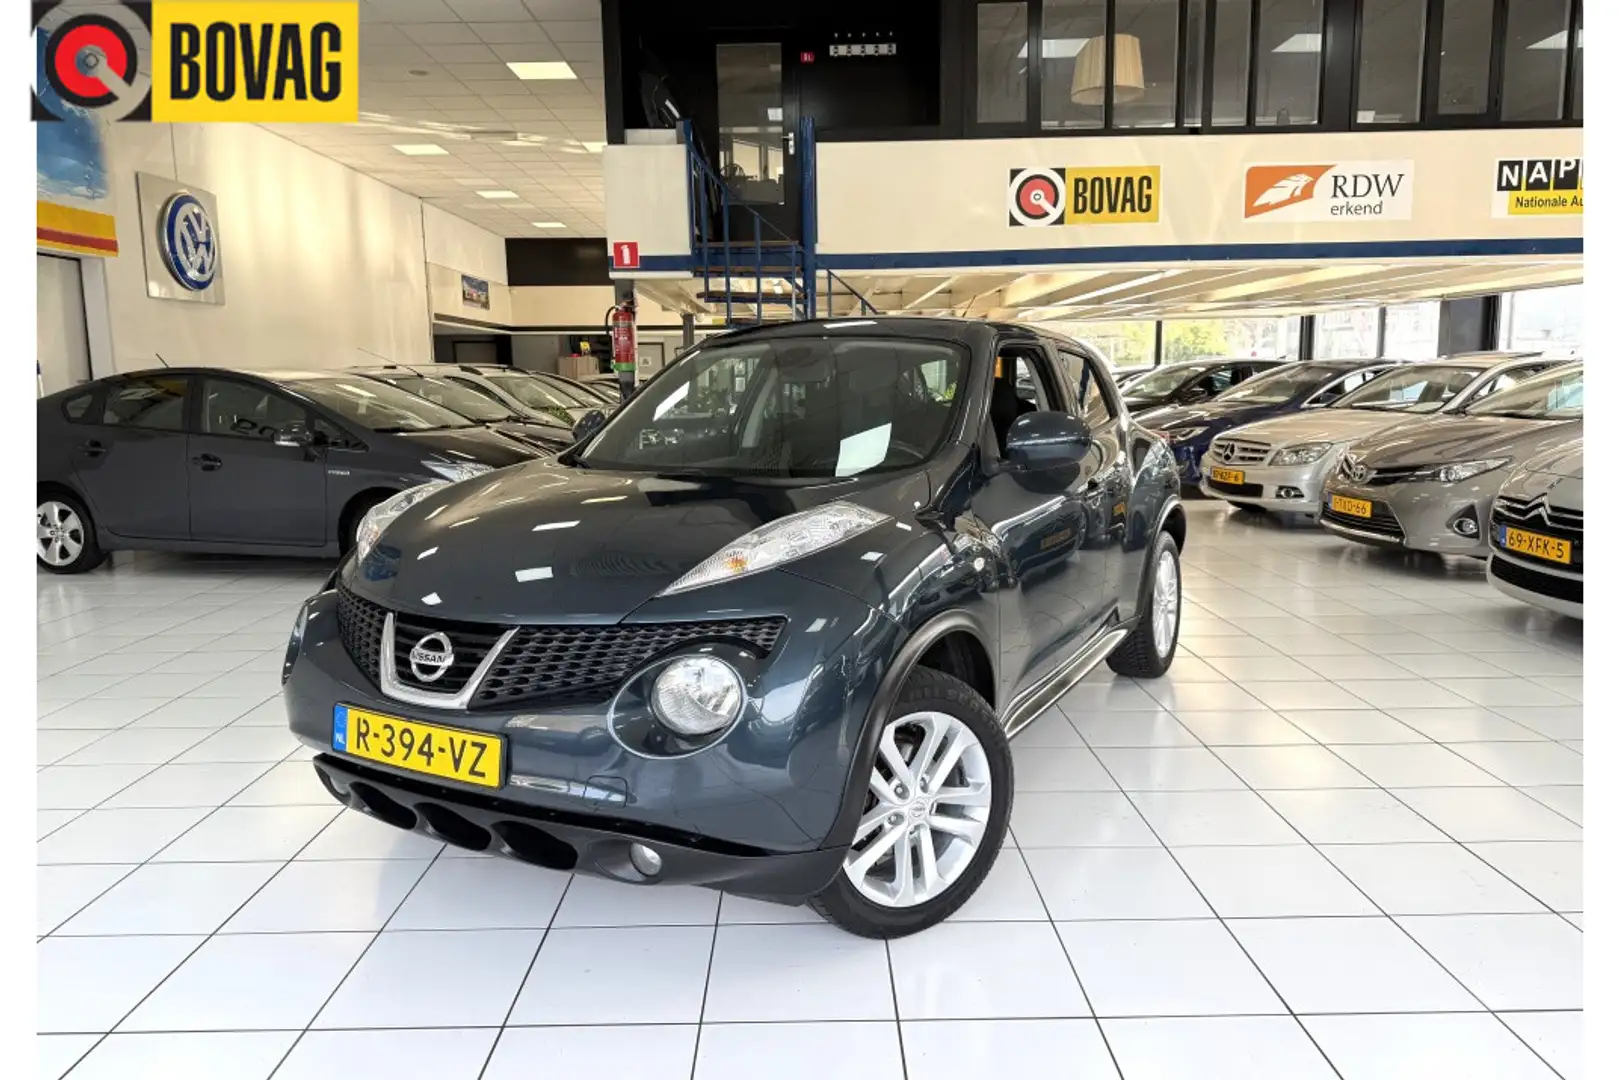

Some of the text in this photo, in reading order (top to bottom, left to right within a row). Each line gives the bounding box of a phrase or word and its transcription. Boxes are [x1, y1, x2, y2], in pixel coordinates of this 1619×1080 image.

[1073, 175, 1152, 214] BOVAG
[1330, 173, 1405, 198] RDW
[1330, 200, 1384, 215] erkend
[1514, 195, 1568, 208] Nationale
[1508, 531, 1564, 559] 69-XFK-5
[411, 650, 447, 664] NISSAN
[335, 733, 346, 745] NL
[355, 716, 488, 779] R-394-VZ
